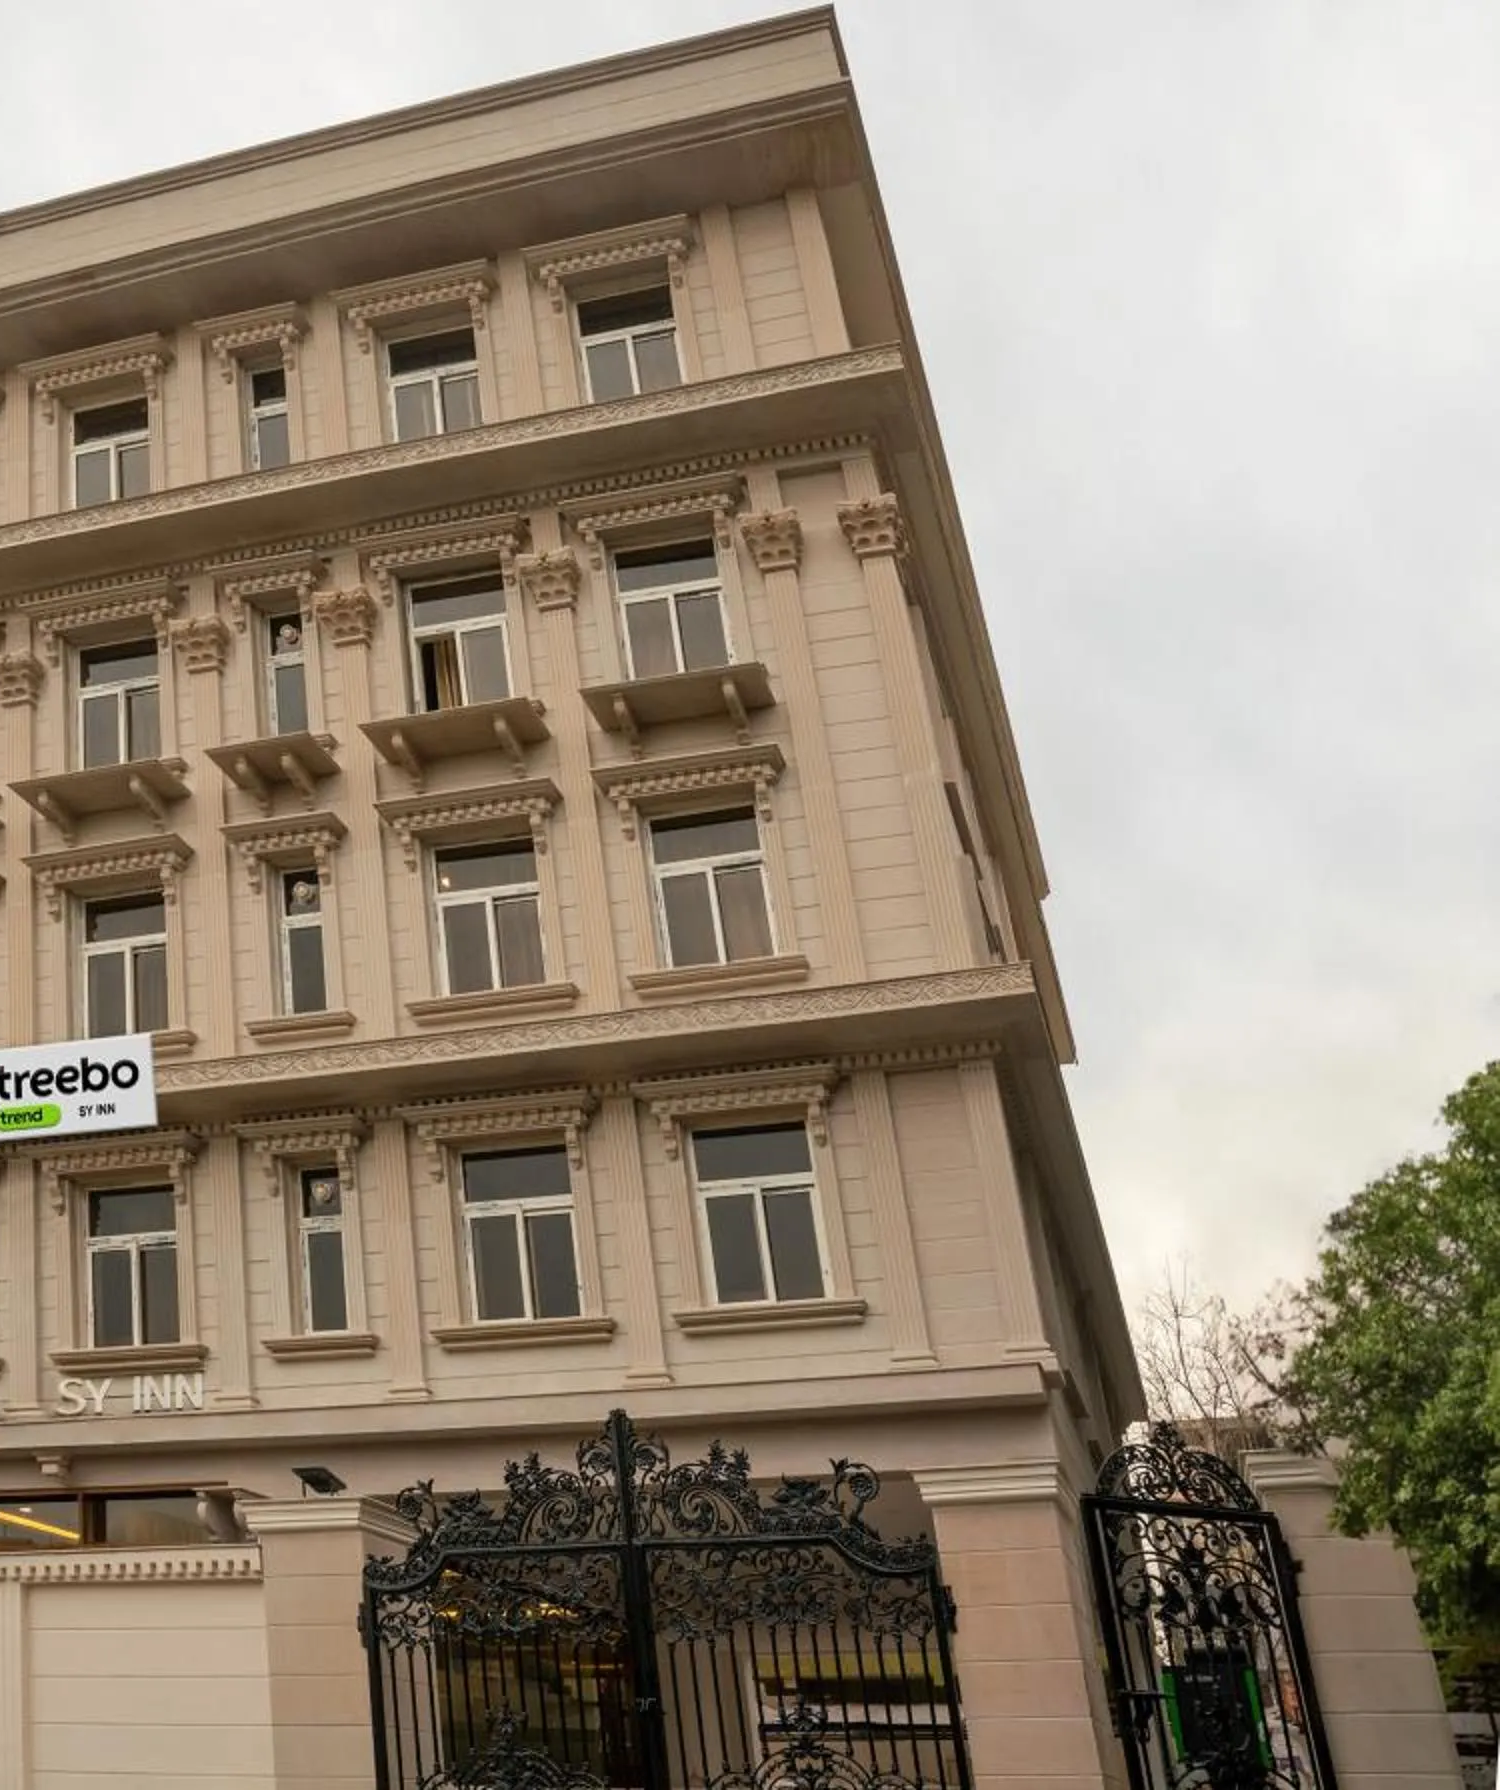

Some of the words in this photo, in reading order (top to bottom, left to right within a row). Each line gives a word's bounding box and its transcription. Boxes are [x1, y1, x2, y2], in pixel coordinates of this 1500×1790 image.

[0, 1107, 44, 1125] trend
[79, 1104, 94, 1118] SY
[96, 1102, 116, 1116] INN
[54, 1376, 113, 1417] SY
[132, 1373, 203, 1414] INN
